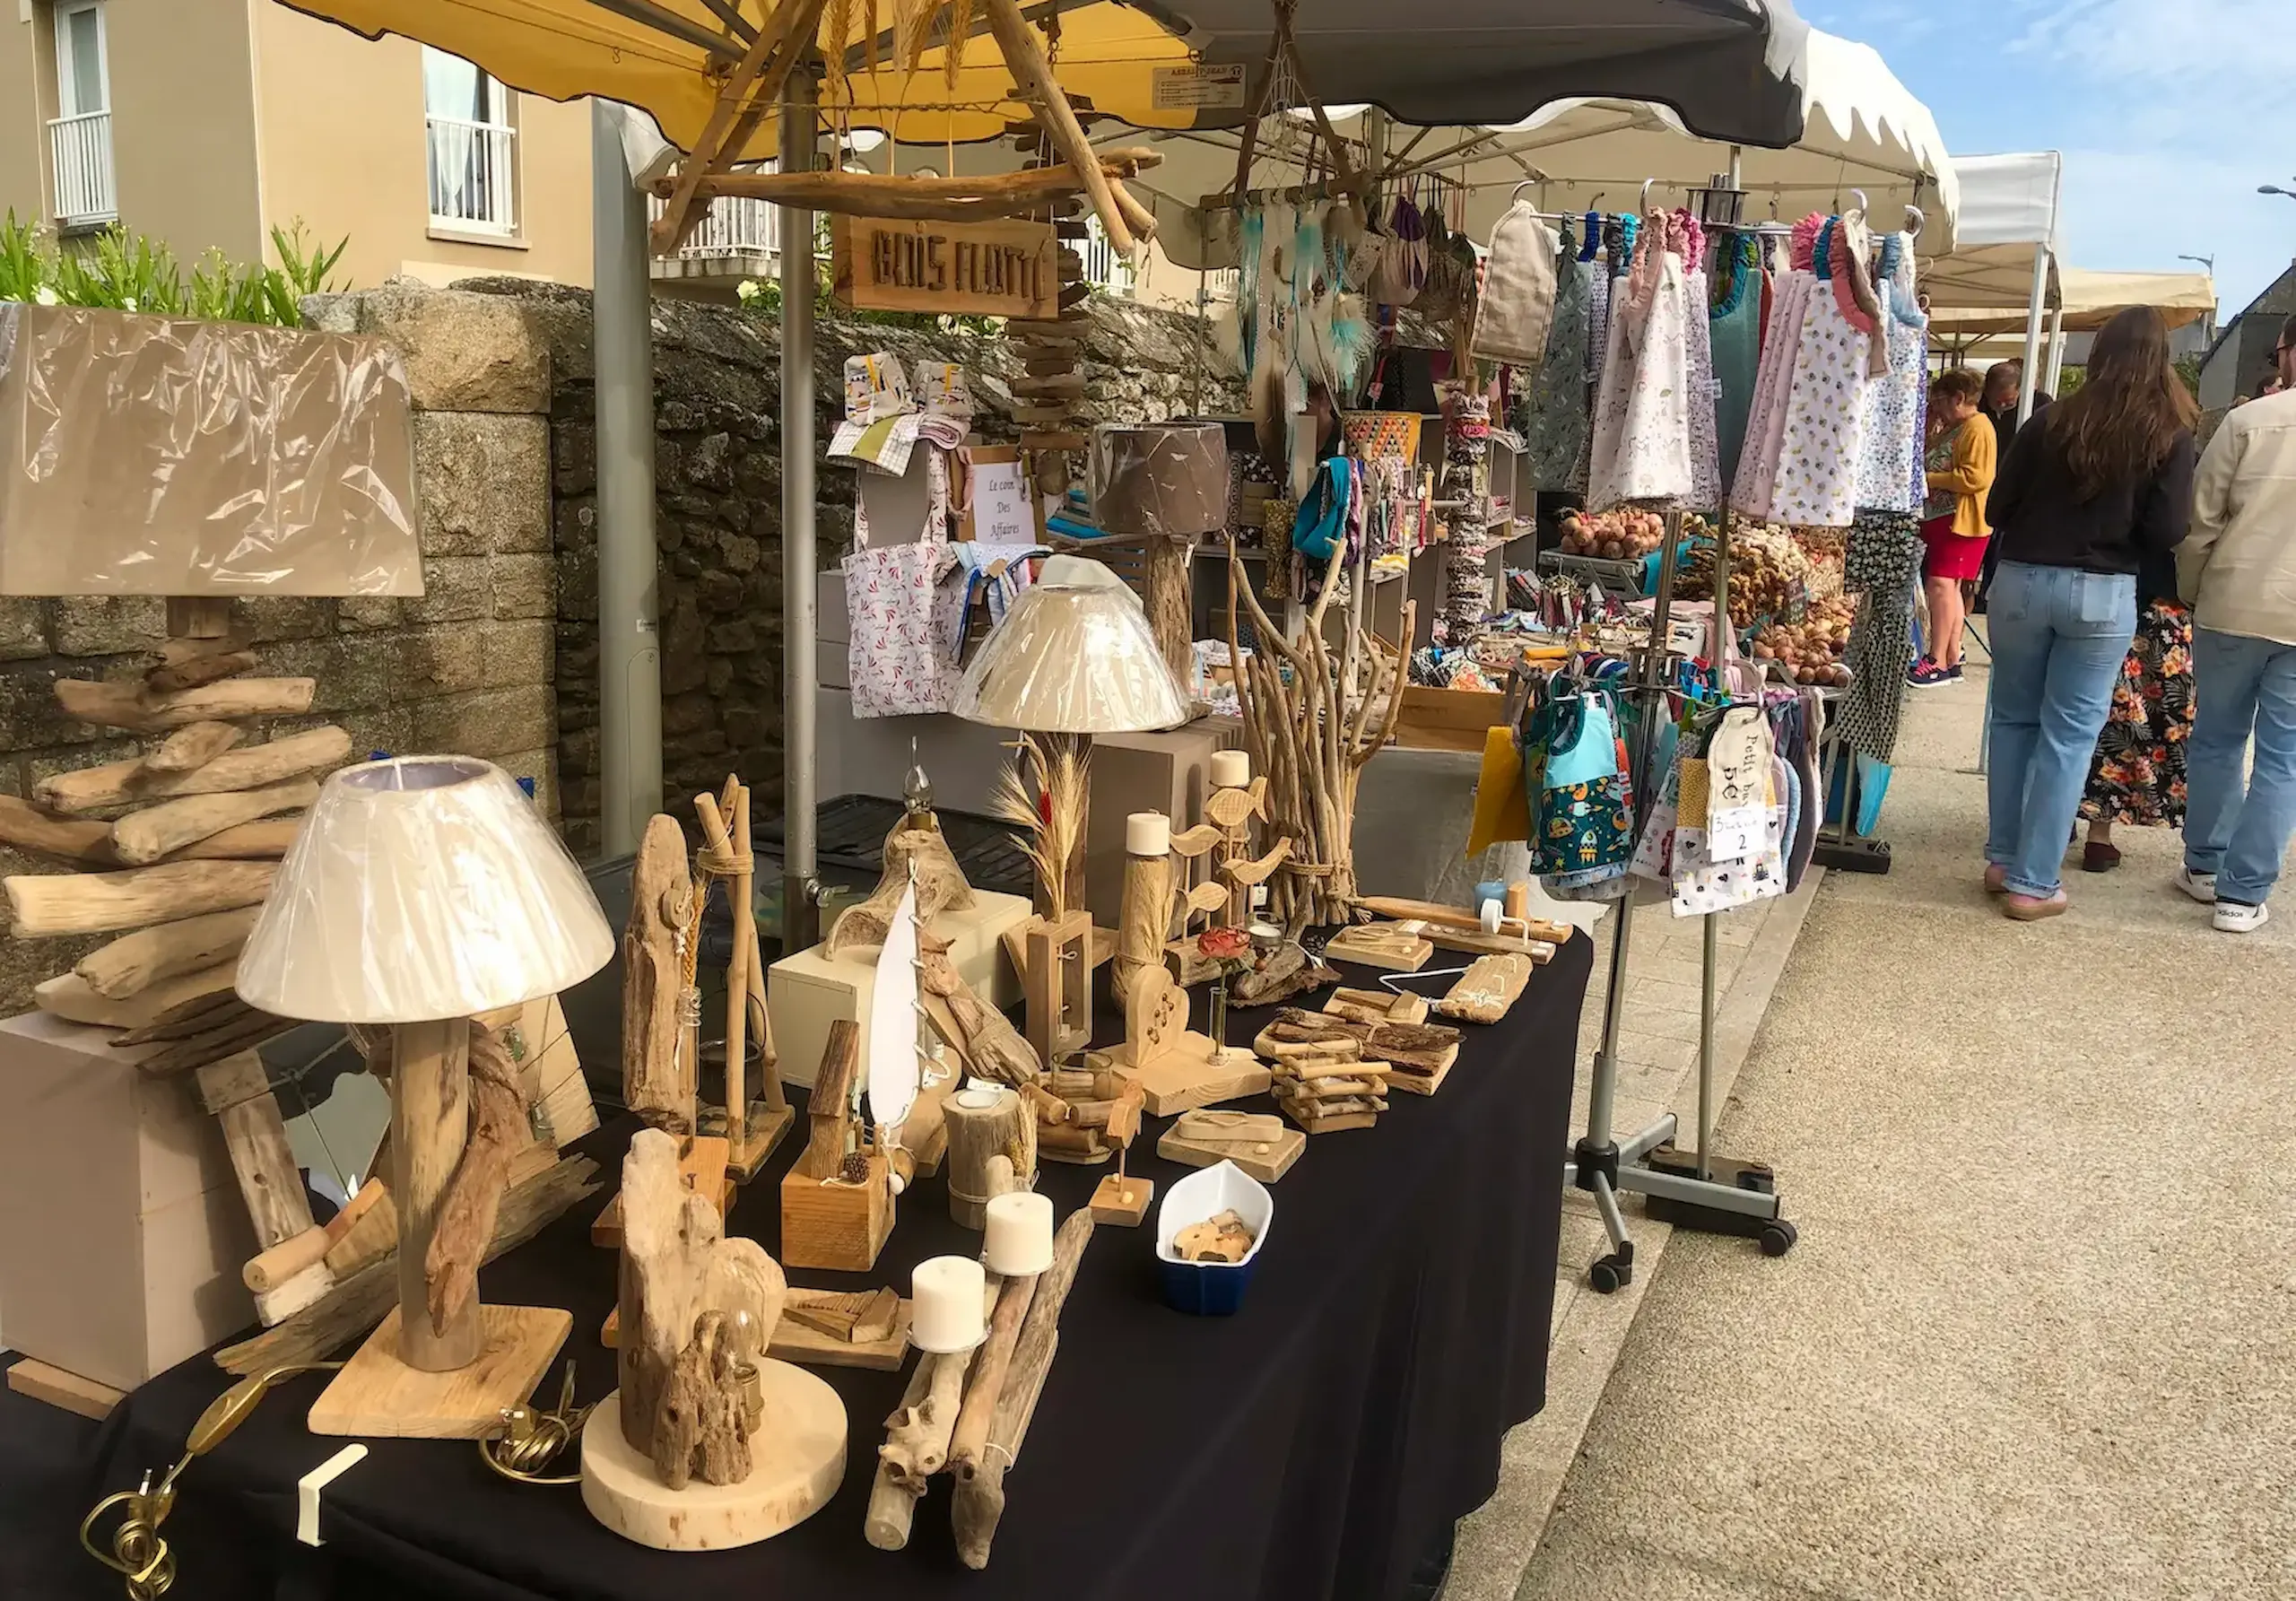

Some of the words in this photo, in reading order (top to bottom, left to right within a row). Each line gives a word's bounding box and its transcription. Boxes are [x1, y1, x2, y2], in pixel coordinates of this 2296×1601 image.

[988, 479, 998, 492] Le
[999, 480, 1015, 491] coin
[996, 501, 1012, 514] Des
[990, 522, 1020, 541] Affaires
[1743, 735, 1760, 774] Petit
[2217, 909, 2244, 918] adidas
